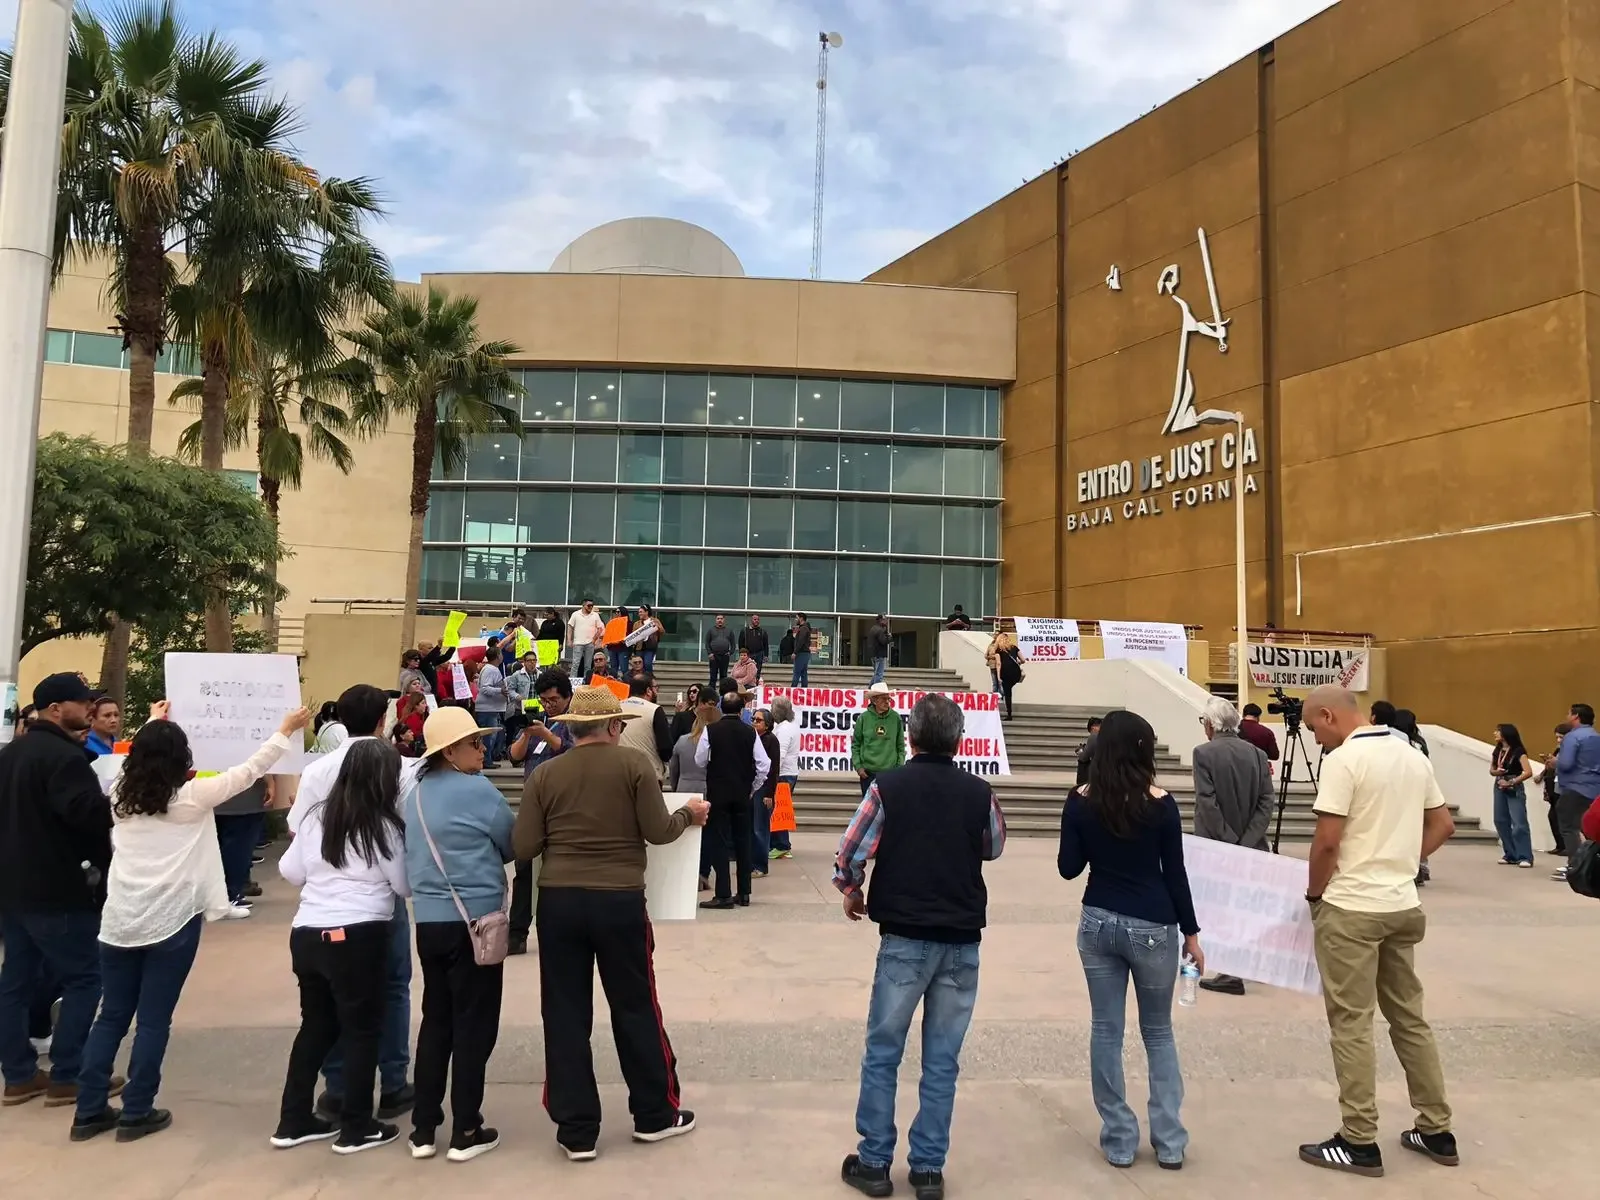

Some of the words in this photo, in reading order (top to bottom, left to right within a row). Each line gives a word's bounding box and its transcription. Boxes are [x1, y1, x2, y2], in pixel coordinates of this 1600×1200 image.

[1077, 460, 1133, 503] ENTRO
[1140, 455, 1163, 492] DE
[1067, 506, 1113, 531] BAJA
[1172, 474, 1257, 508] FORNA
[1032, 643, 1067, 657] JESÚS
[1272, 672, 1297, 684] JESUS
